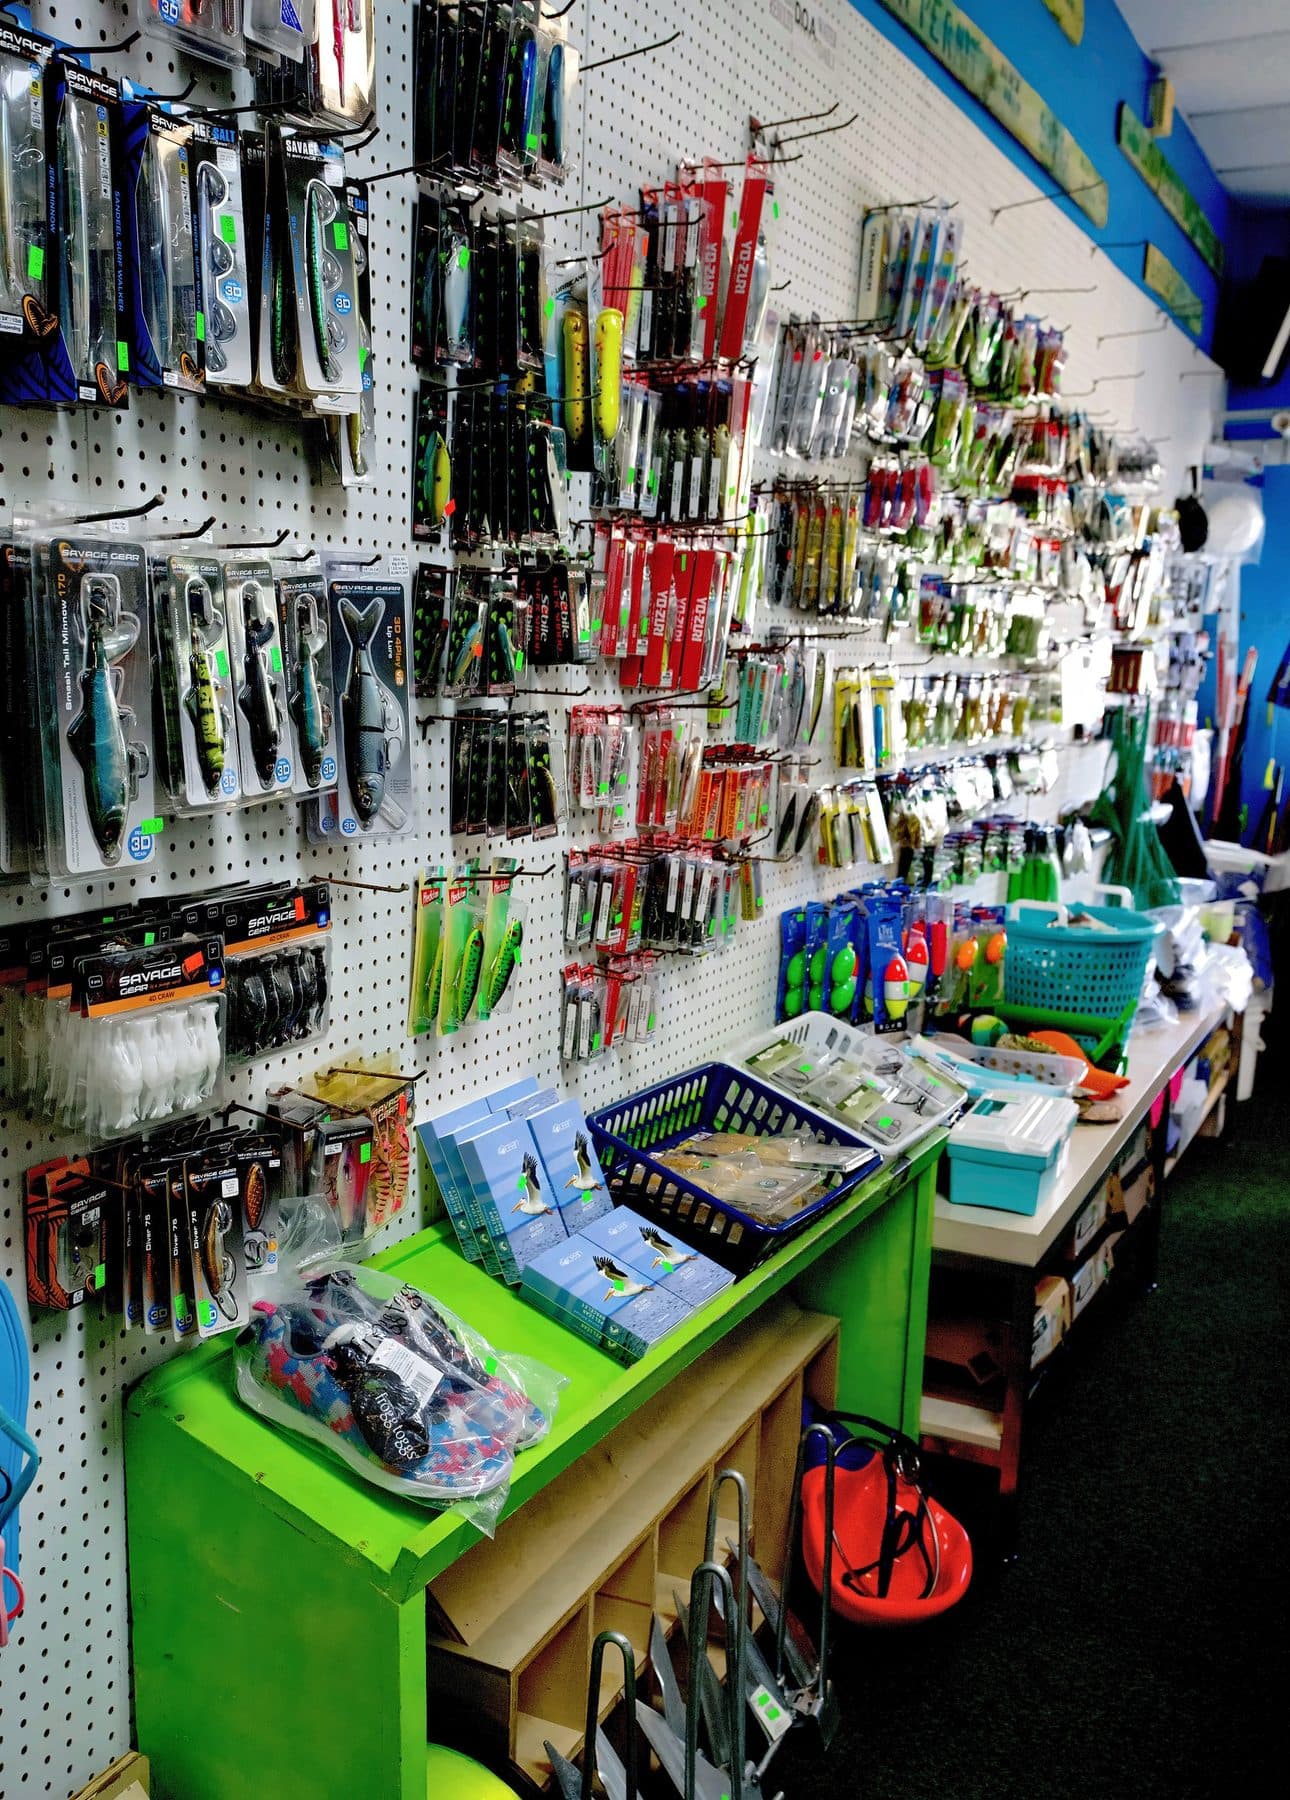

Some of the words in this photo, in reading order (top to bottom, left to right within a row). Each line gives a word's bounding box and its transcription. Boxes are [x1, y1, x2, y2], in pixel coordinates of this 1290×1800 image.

[0, 28, 53, 57] AVAGE
[67, 70, 118, 98] SAVAGE
[68, 81, 92, 95] GEAR
[212, 126, 236, 144] SALT
[114, 190, 123, 238] SANDEEL
[703, 243, 719, 296] YO-ZURI
[734, 240, 752, 295] YO-ZURI
[224, 285, 242, 298] 3D
[335, 299, 350, 310] 3D
[61, 549, 108, 560] SAVAGE
[111, 553, 140, 562] GEAR
[57, 573, 66, 597] 170
[61, 600, 70, 645] Minnow
[541, 594, 550, 642] Sebile
[559, 591, 570, 639] Sebile
[653, 590, 669, 637] YO-ZURI
[675, 597, 687, 642] YO-ZURI
[692, 597, 708, 642] YO-ZURI
[393, 616, 402, 634] 3D
[63, 648, 71, 668] Tail
[65, 670, 73, 711] Smash
[277, 766, 290, 776] 3D
[322, 764, 335, 775] 3D
[222, 777, 236, 787] 3D
[343, 822, 356, 831] 3D
[131, 837, 152, 851] 3D
[248, 909, 297, 929] SAVAGE
[248, 925, 271, 937] GEAR
[119, 965, 182, 987] SAVAGE
[119, 984, 148, 996] GEAR
[157, 991, 176, 1001] CRAW
[70, 1191, 107, 1210] SAVAGE
[145, 1214, 151, 1225] 75
[172, 1218, 178, 1229] 75
[191, 1210, 198, 1221] 75
[150, 1309, 168, 1321] 3D
[375, 1392, 398, 1430] frogg
[393, 1424, 421, 1461] toggs
